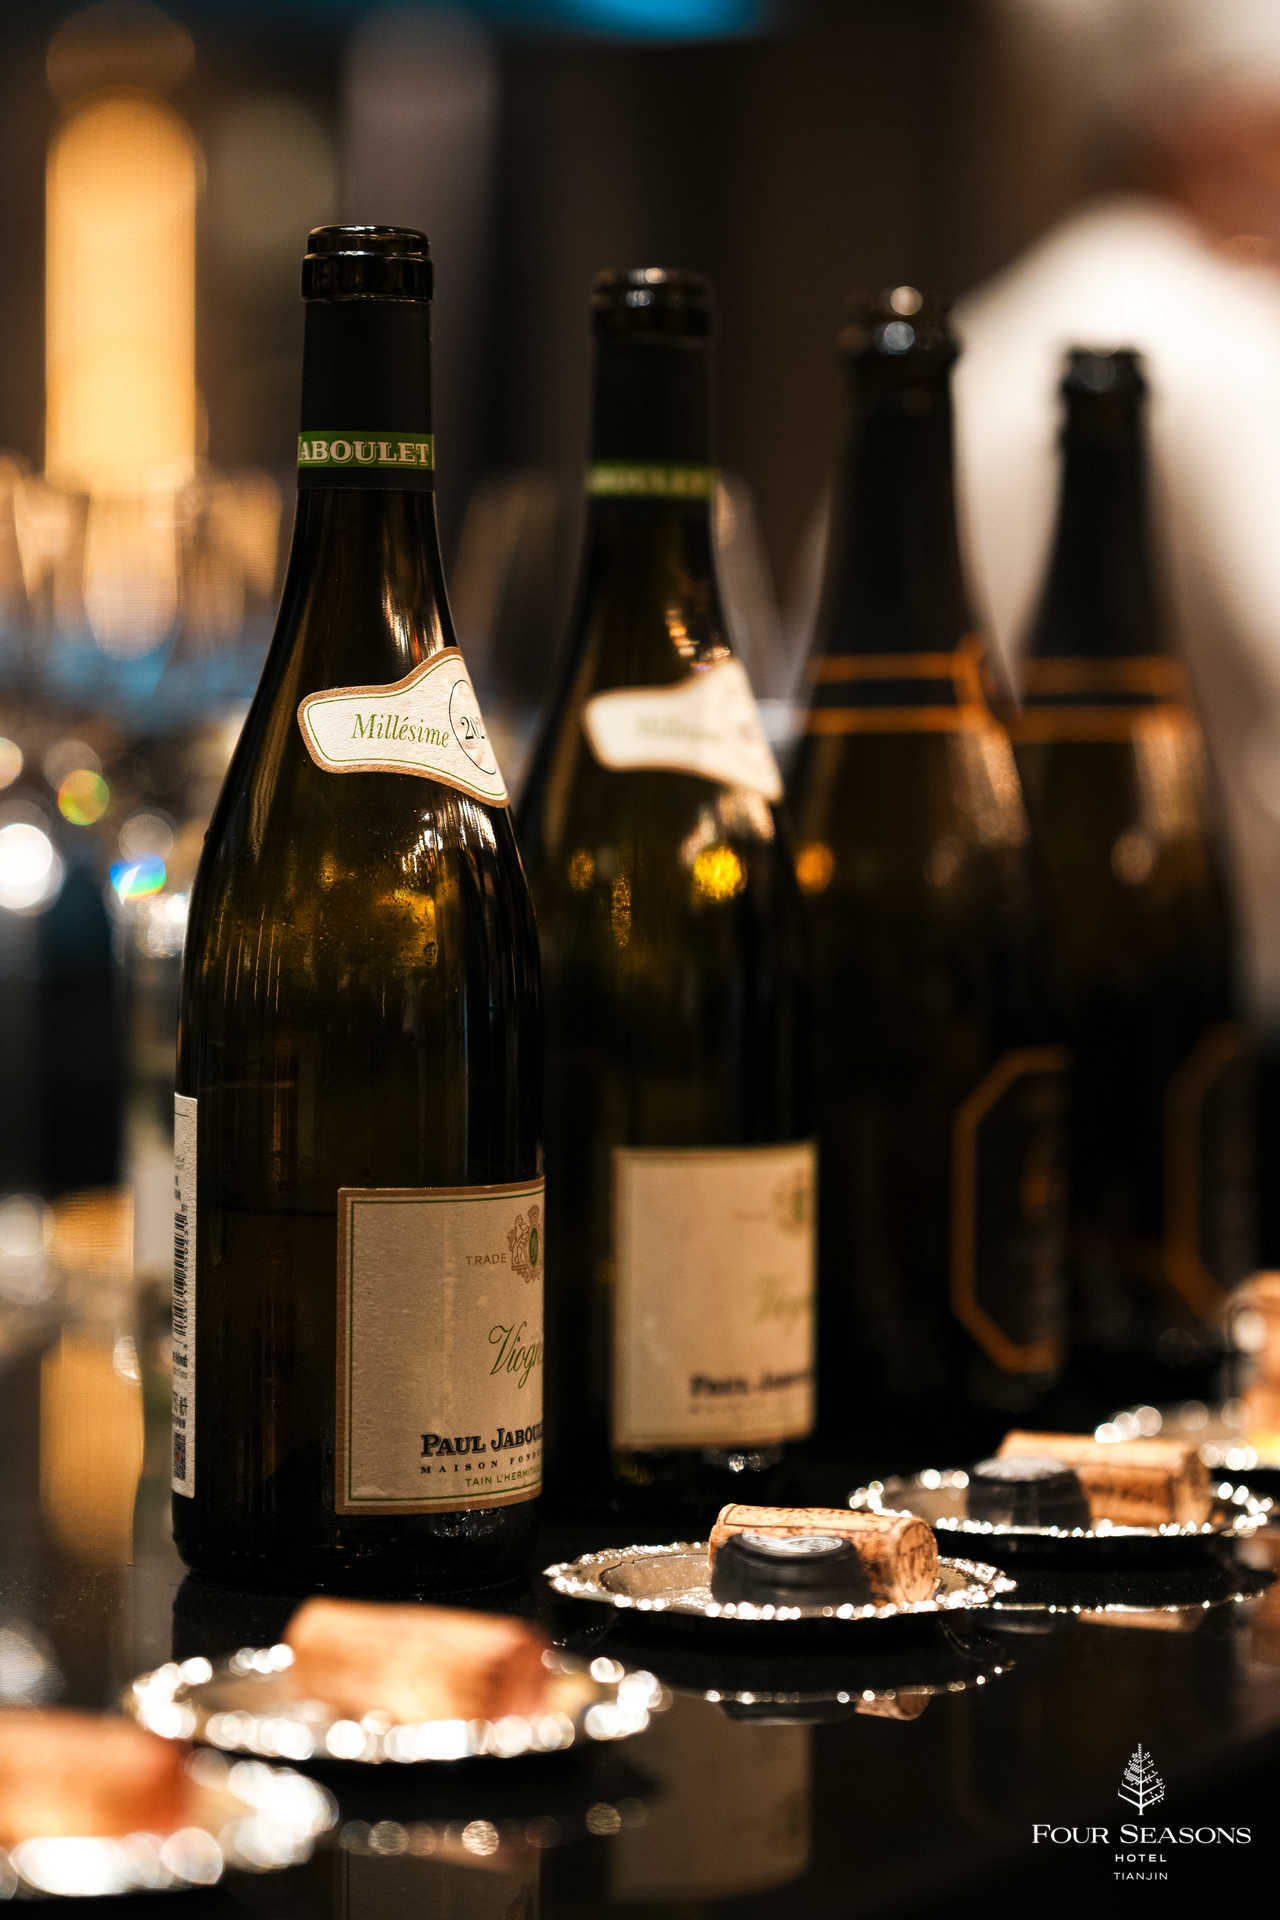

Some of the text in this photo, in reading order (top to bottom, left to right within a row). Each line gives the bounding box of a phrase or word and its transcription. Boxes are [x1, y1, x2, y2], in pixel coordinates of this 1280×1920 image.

[298, 437, 429, 465] ABOULET
[351, 713, 450, 748] Millésime
[465, 1252, 508, 1266] TRADE
[488, 1320, 542, 1390] Viog
[420, 1433, 487, 1458] PAUL
[420, 1460, 498, 1475] MAISON
[465, 1476, 493, 1488] TAIN
